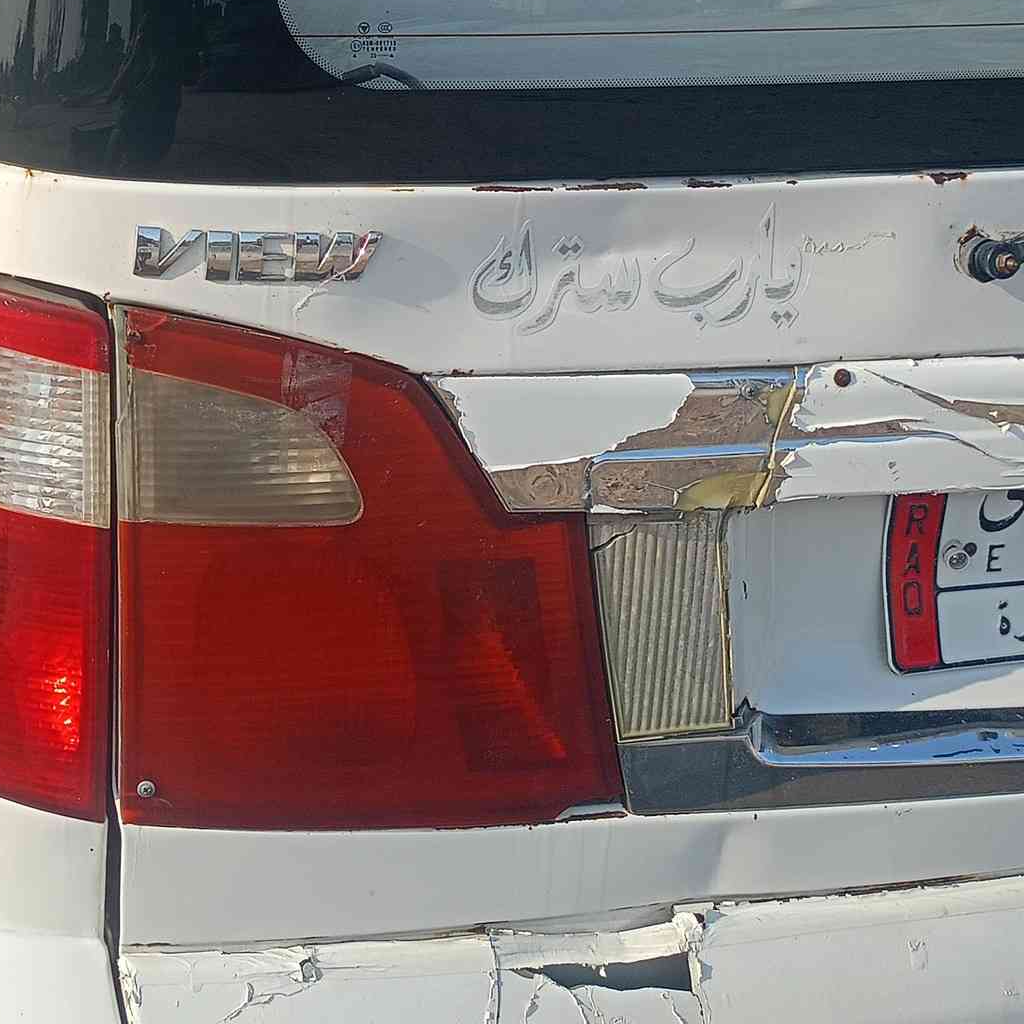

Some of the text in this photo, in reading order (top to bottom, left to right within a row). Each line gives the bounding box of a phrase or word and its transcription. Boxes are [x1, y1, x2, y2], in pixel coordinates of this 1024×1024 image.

[133, 225, 383, 281] VIEW
[902, 494, 929, 616] RAQ
[986, 544, 1005, 573] E
